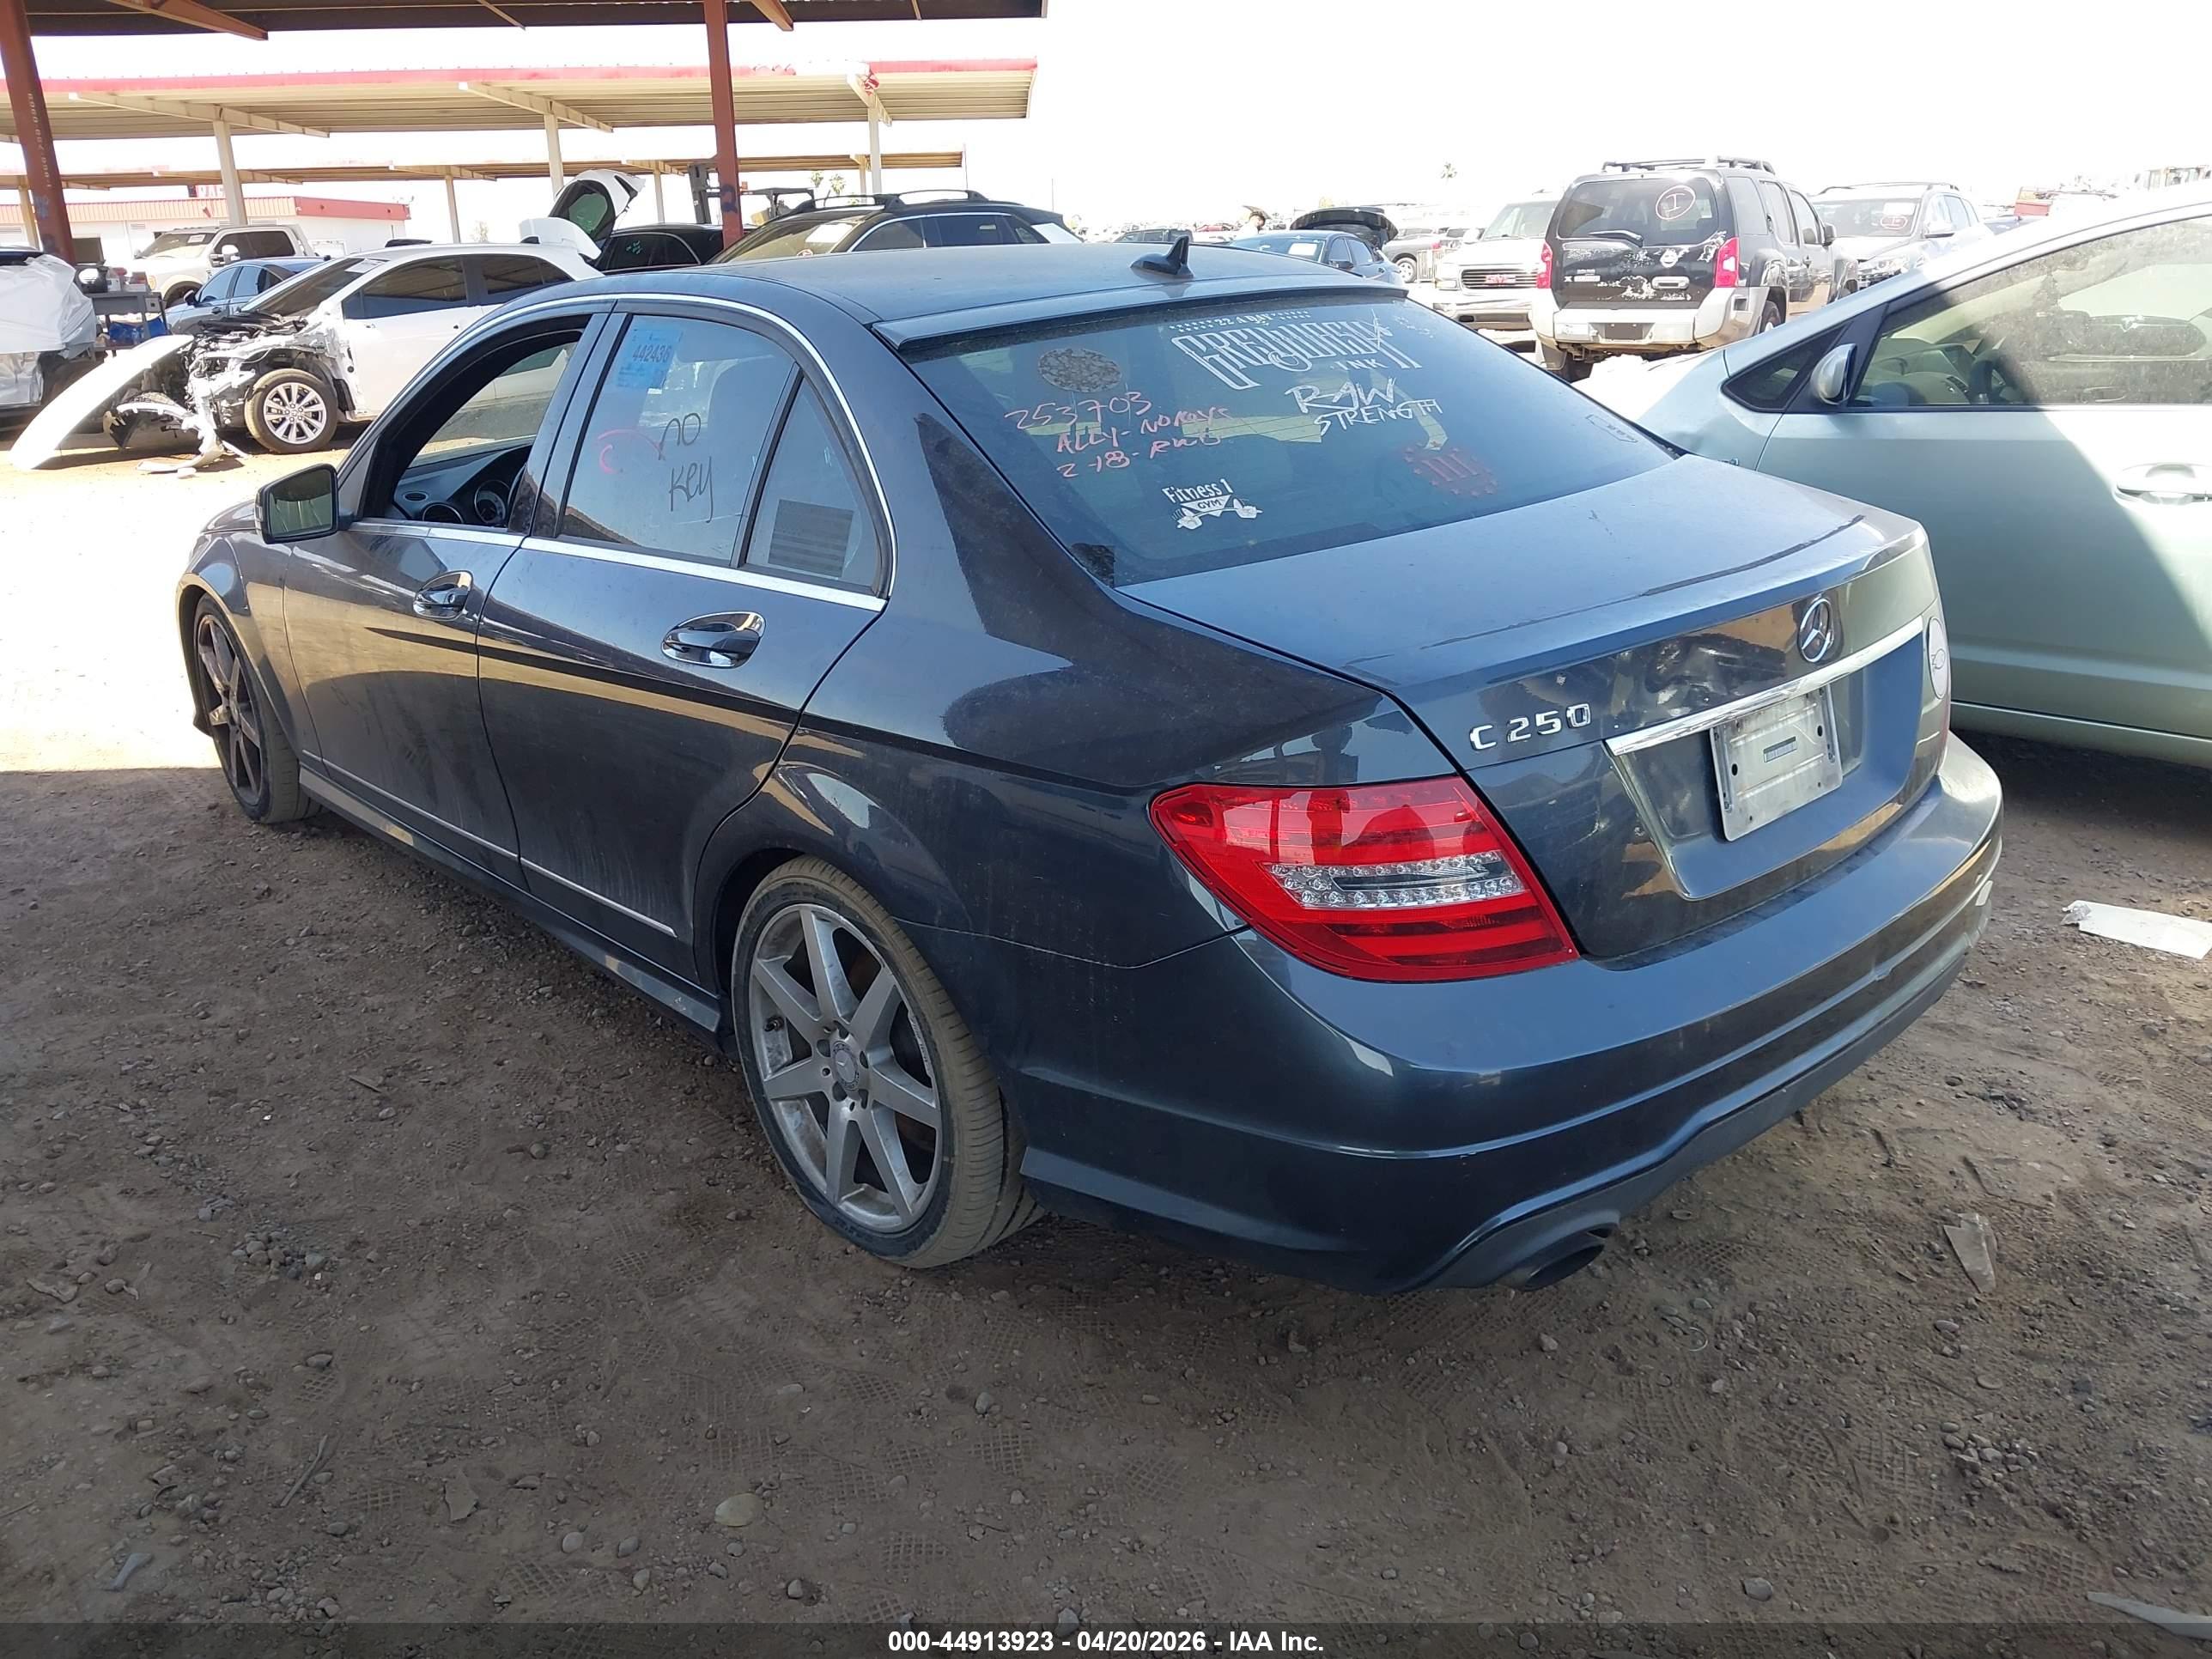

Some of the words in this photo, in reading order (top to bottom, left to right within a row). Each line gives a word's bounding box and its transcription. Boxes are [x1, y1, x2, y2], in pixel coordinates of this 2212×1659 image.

[1218, 318, 1235, 326] 22
[1336, 358, 1389, 371] INK
[1004, 392, 1152, 430] 253703
[1284, 376, 1396, 414] RAW
[1313, 398, 1443, 436] STRENGTH
[1161, 483, 1223, 504] Fitness
[1220, 477, 1234, 494] 1
[1197, 498, 1222, 510] GYM
[1469, 724, 1498, 750] C
[1506, 702, 1591, 743] 250
